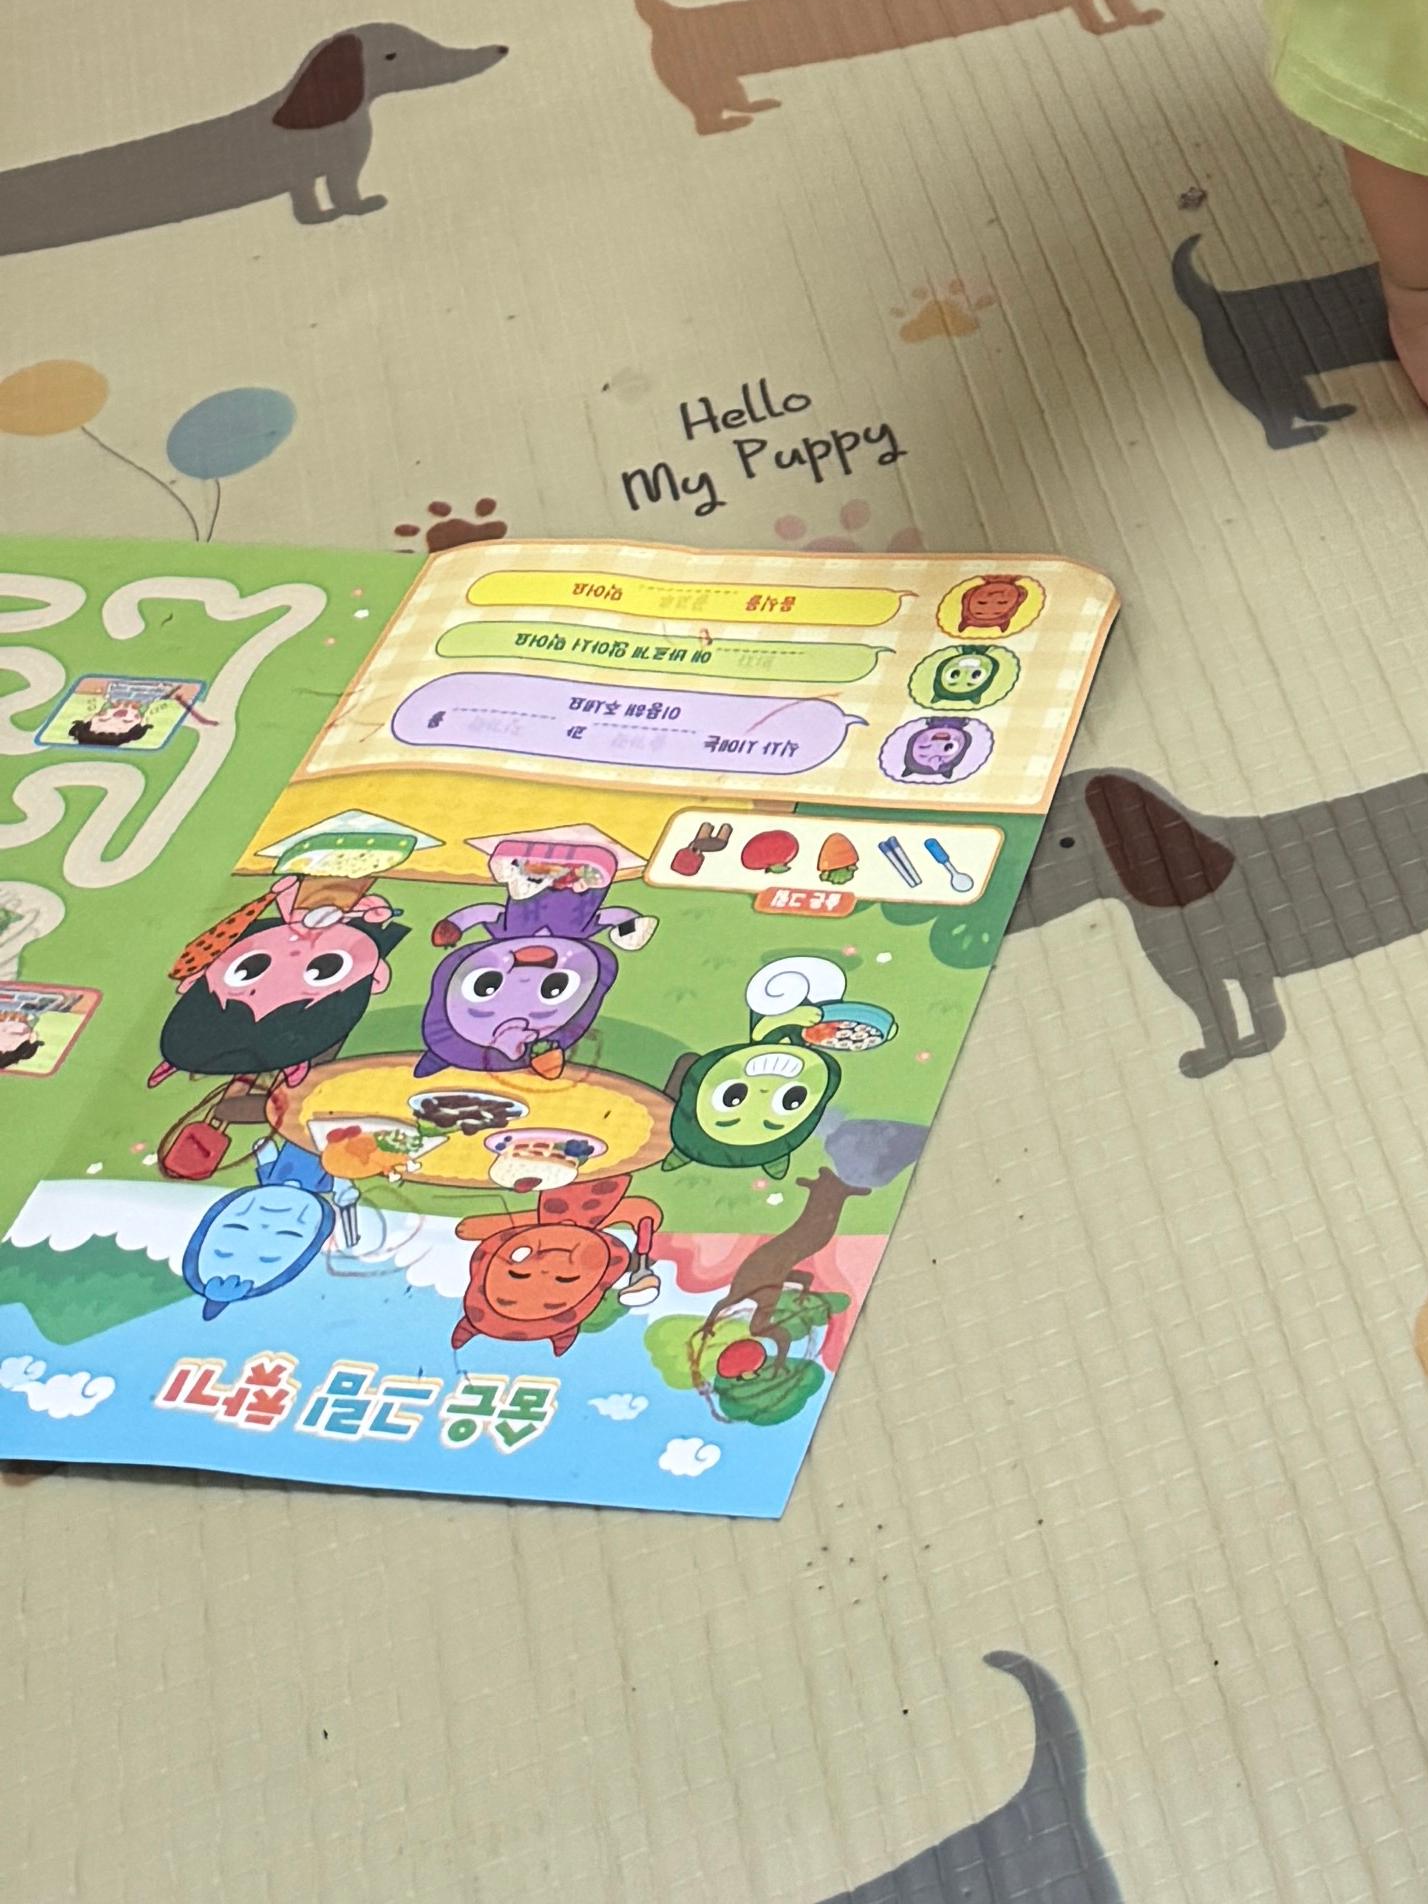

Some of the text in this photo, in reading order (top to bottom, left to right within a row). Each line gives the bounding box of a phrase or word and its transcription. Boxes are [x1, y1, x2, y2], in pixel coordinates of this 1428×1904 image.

[680, 377, 812, 440] Hello
[621, 423, 908, 517] My Puppy
[572, 583, 623, 601] 먹어요
[515, 632, 566, 651] 먹어요
[572, 638, 629, 657] 앉아서
[631, 645, 687, 661] 바르게
[691, 649, 712, 664] 에
[568, 696, 682, 721] 이용해 주세요
[566, 725, 587, 741] 과
[703, 734, 759, 754] 시에는
[762, 740, 799, 759] 식사
[770, 889, 841, 911] 숨은 그림
[154, 1352, 558, 1452] 숨은 그림 찾기
